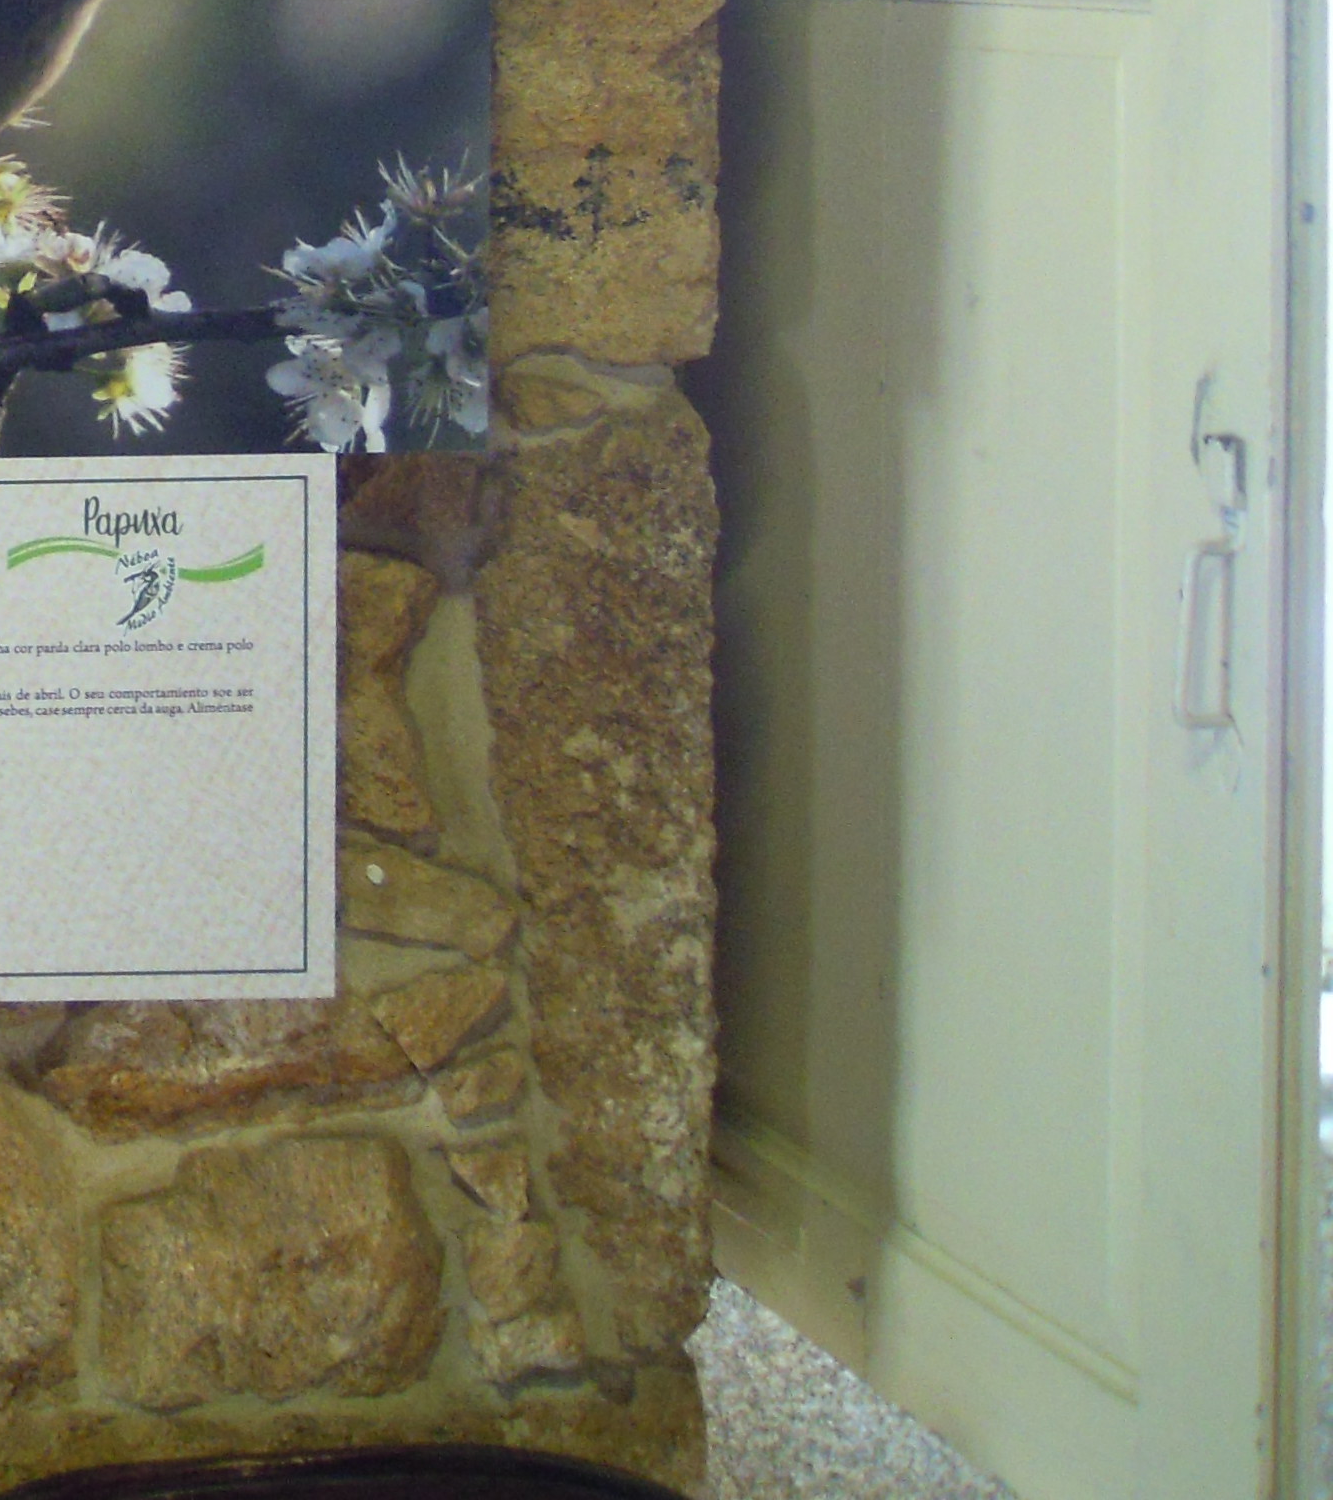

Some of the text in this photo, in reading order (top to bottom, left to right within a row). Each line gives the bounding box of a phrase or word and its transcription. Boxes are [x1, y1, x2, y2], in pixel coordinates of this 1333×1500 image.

[84, 496, 183, 547] Papuxa
[13, 645, 32, 655] cor
[37, 641, 69, 656] parda
[73, 640, 100, 654] clara
[104, 640, 131, 655] polo
[134, 639, 173, 653] lombo
[187, 642, 223, 652] crema
[227, 637, 254, 653] polo
[16, 688, 30, 701] de
[84, 690, 104, 700] seu
[212, 688, 232, 698] soe
[237, 688, 254, 698] ser
[35, 707, 60, 717] case
[61, 706, 105, 719] sempre
[107, 705, 137, 715] cerca
[140, 701, 153, 715] da
